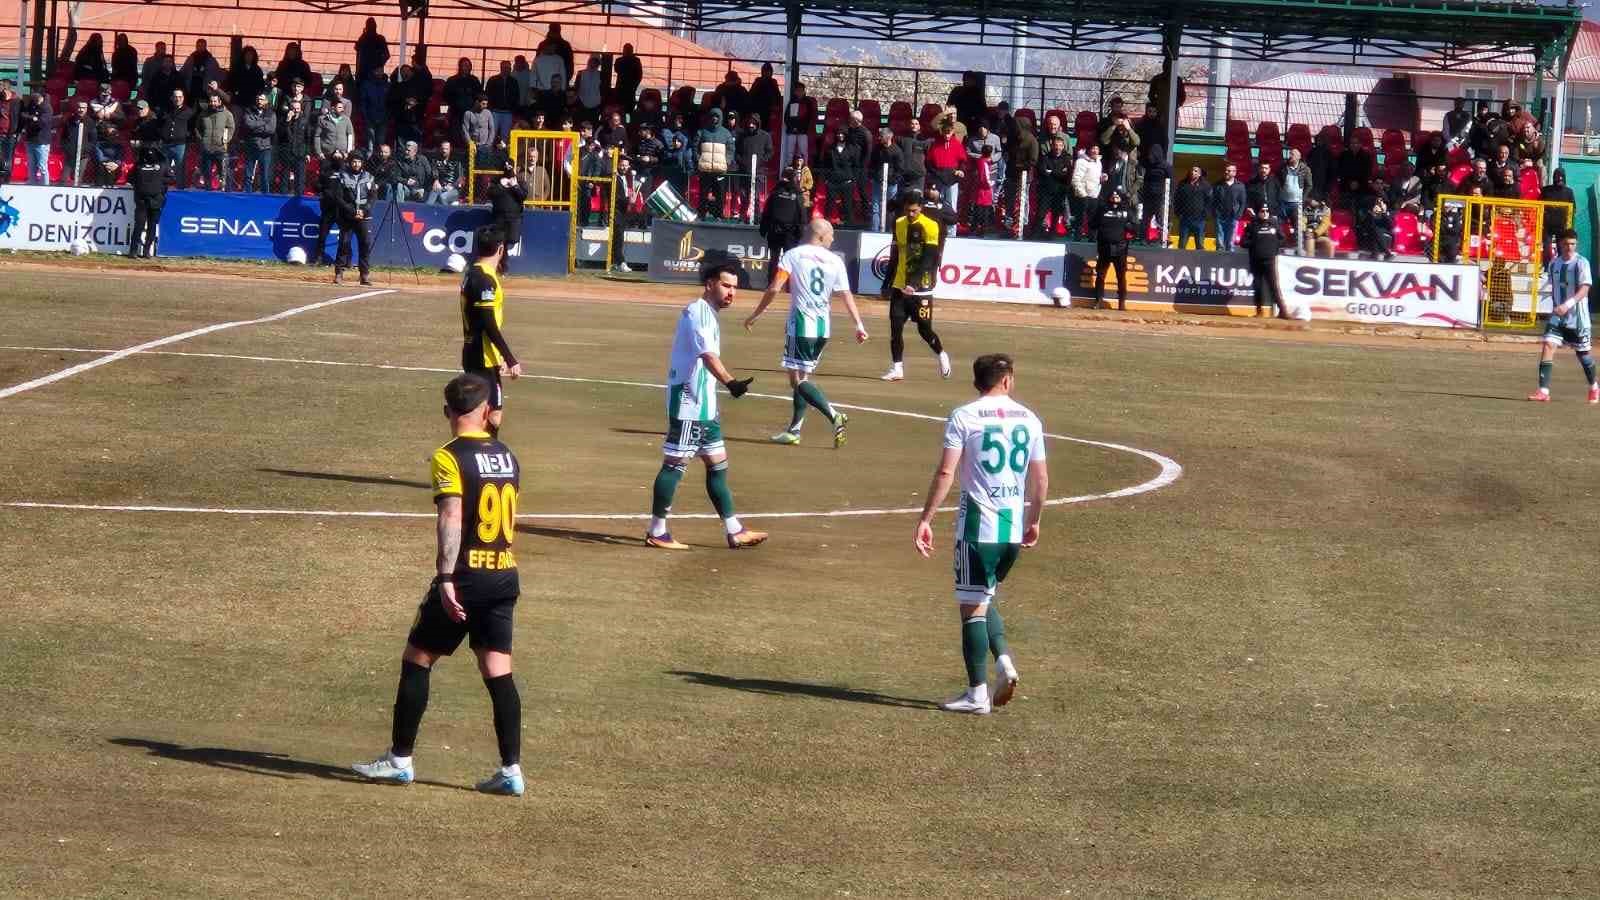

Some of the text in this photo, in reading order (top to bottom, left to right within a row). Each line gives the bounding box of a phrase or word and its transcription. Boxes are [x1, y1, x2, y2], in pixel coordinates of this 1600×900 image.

[50, 193, 127, 215] CUNDA
[28, 219, 131, 246] DENİZCİLİ
[810, 266, 825, 296] 8
[1293, 265, 1462, 301] SEKVAN
[1345, 302, 1406, 317] GROUP
[981, 423, 1031, 475] 58
[477, 482, 517, 544] 90
[469, 549, 496, 570] EFE
